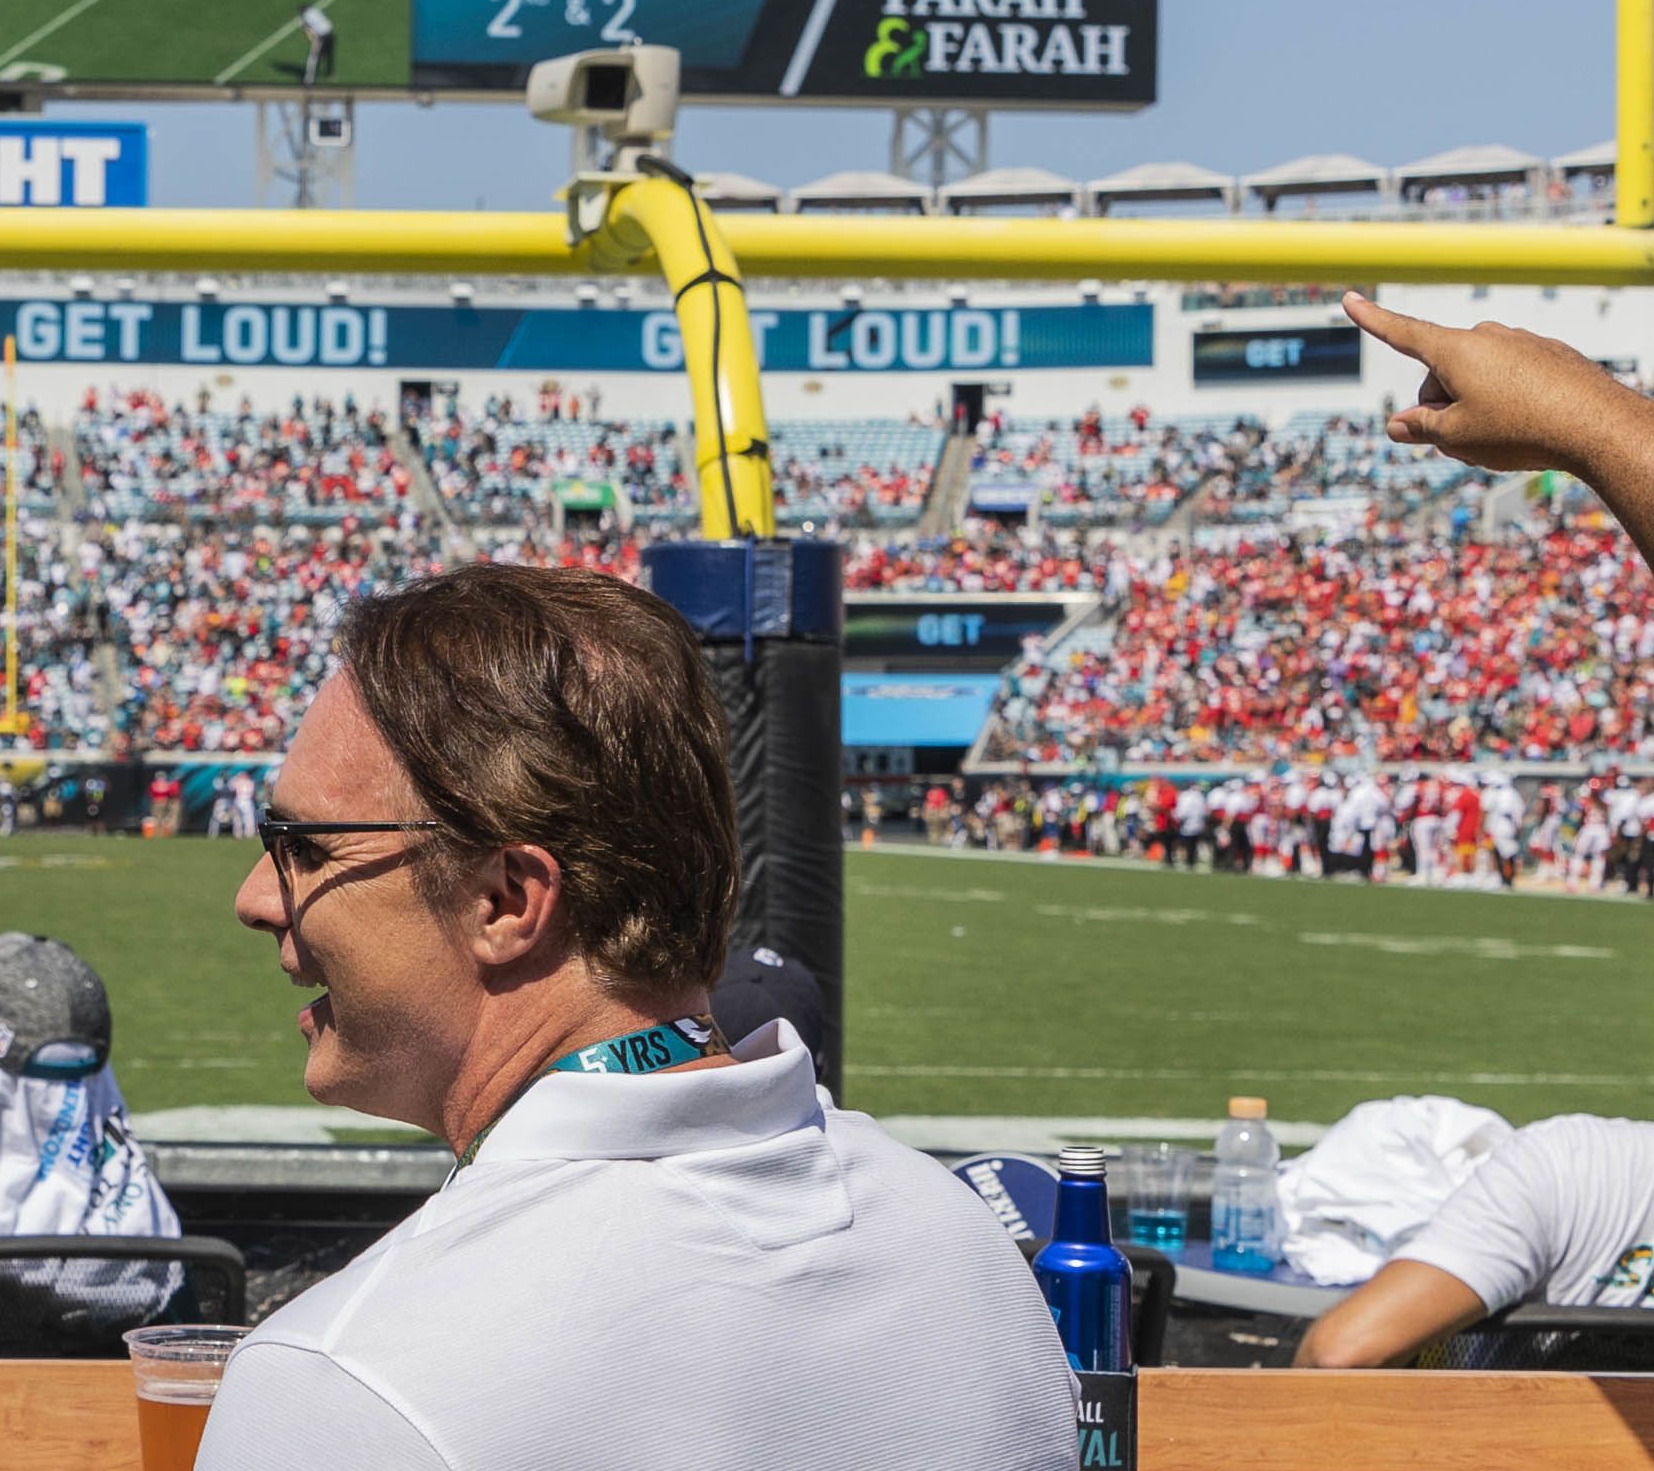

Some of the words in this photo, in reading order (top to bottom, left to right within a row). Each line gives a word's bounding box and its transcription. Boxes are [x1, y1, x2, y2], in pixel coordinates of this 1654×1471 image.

[924, 23, 1130, 76] FARAH
[15, 301, 153, 361] GET
[180, 304, 389, 366] LOUD!
[640, 311, 780, 369] GT
[808, 310, 1022, 369] LOUD!
[1245, 337, 1306, 369] GET
[917, 613, 985, 647] GET
[608, 1031, 673, 1075] YRS
